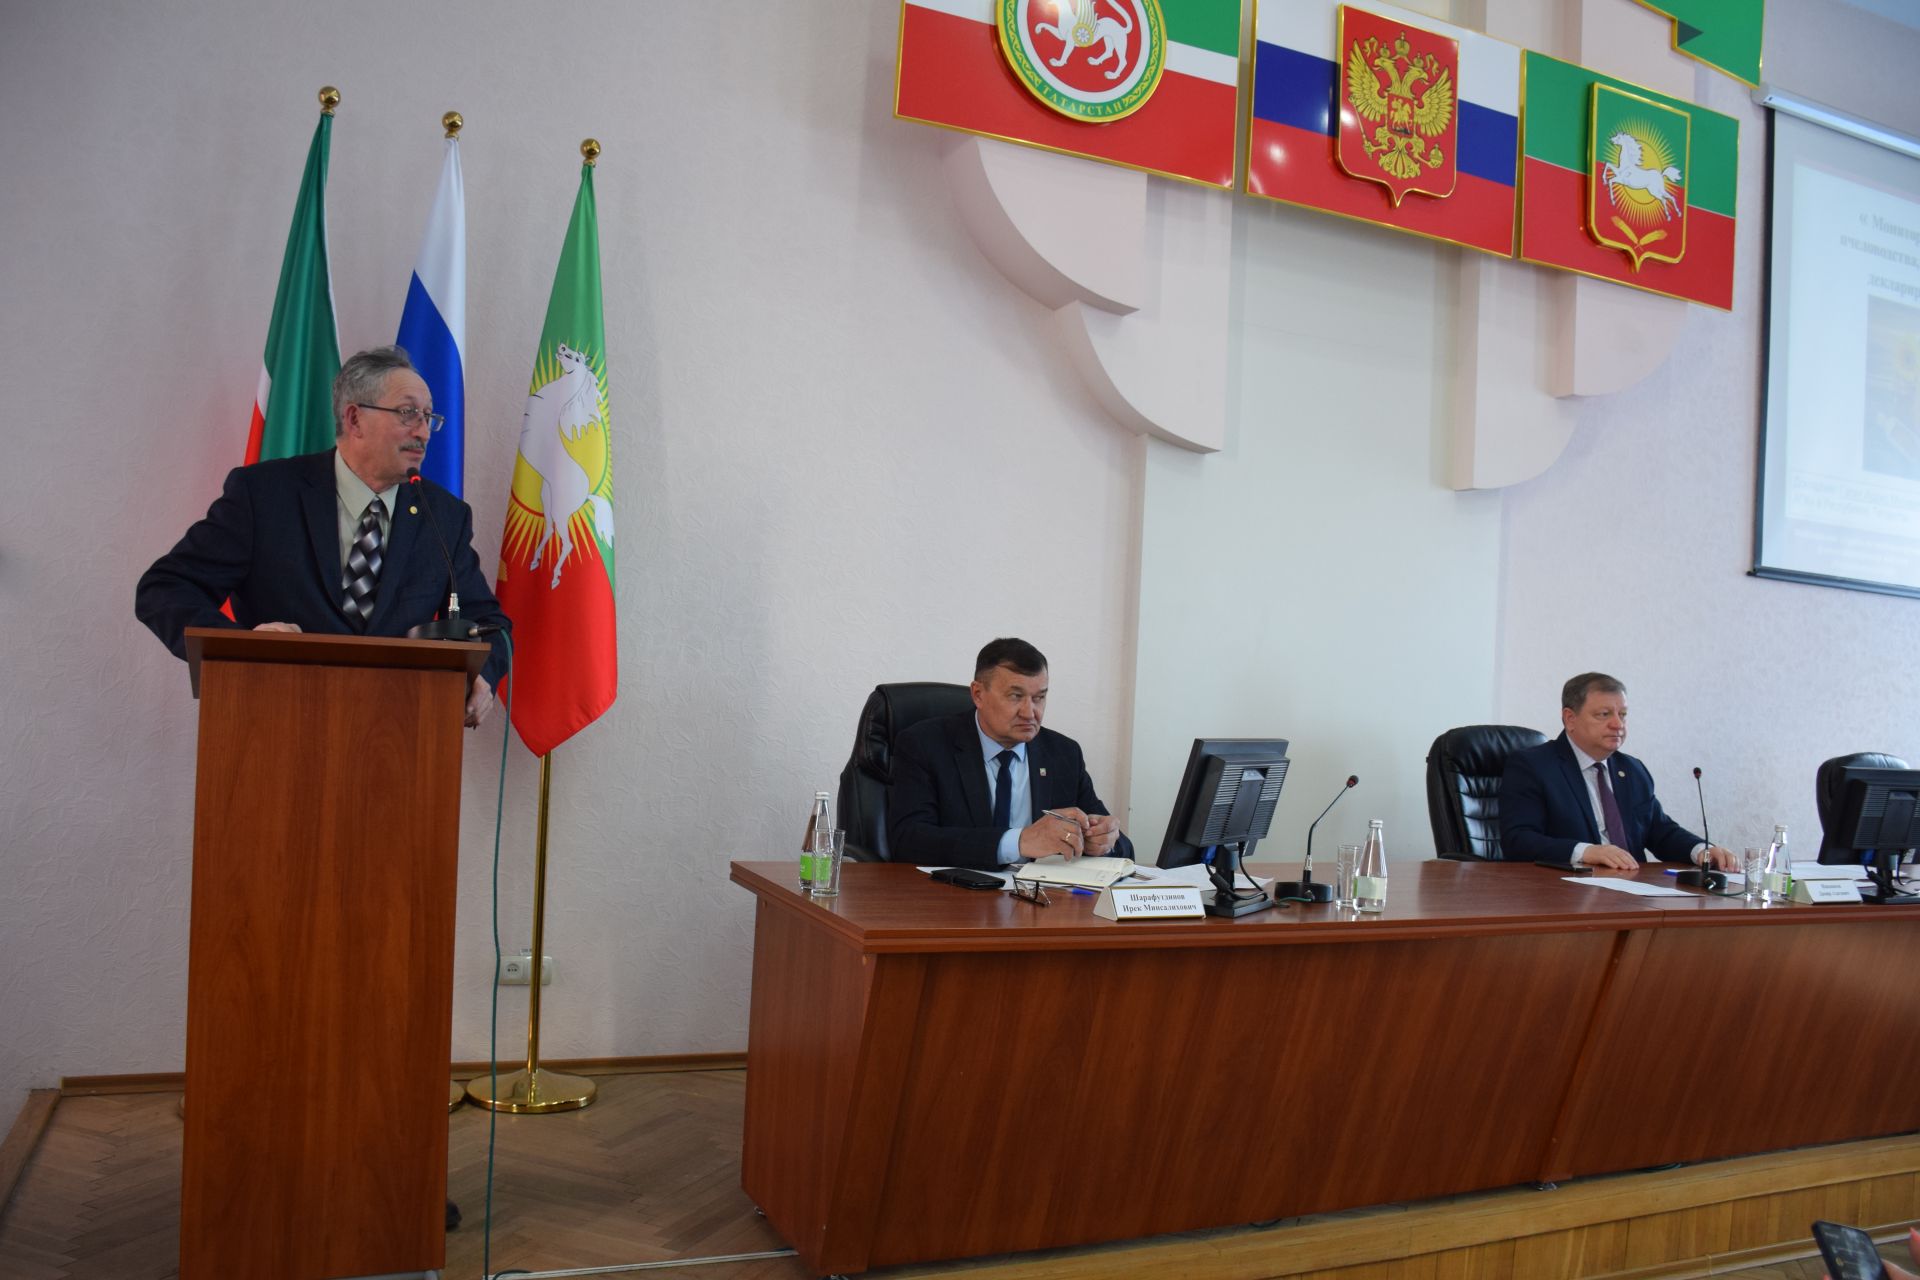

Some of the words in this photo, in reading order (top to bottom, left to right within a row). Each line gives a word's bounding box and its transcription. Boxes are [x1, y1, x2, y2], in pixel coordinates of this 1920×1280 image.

[1041, 86, 1124, 116] ТАТАРСТАН
[1130, 893, 1185, 903] Шарафутдинов
[1122, 905, 1142, 914] Ирек
